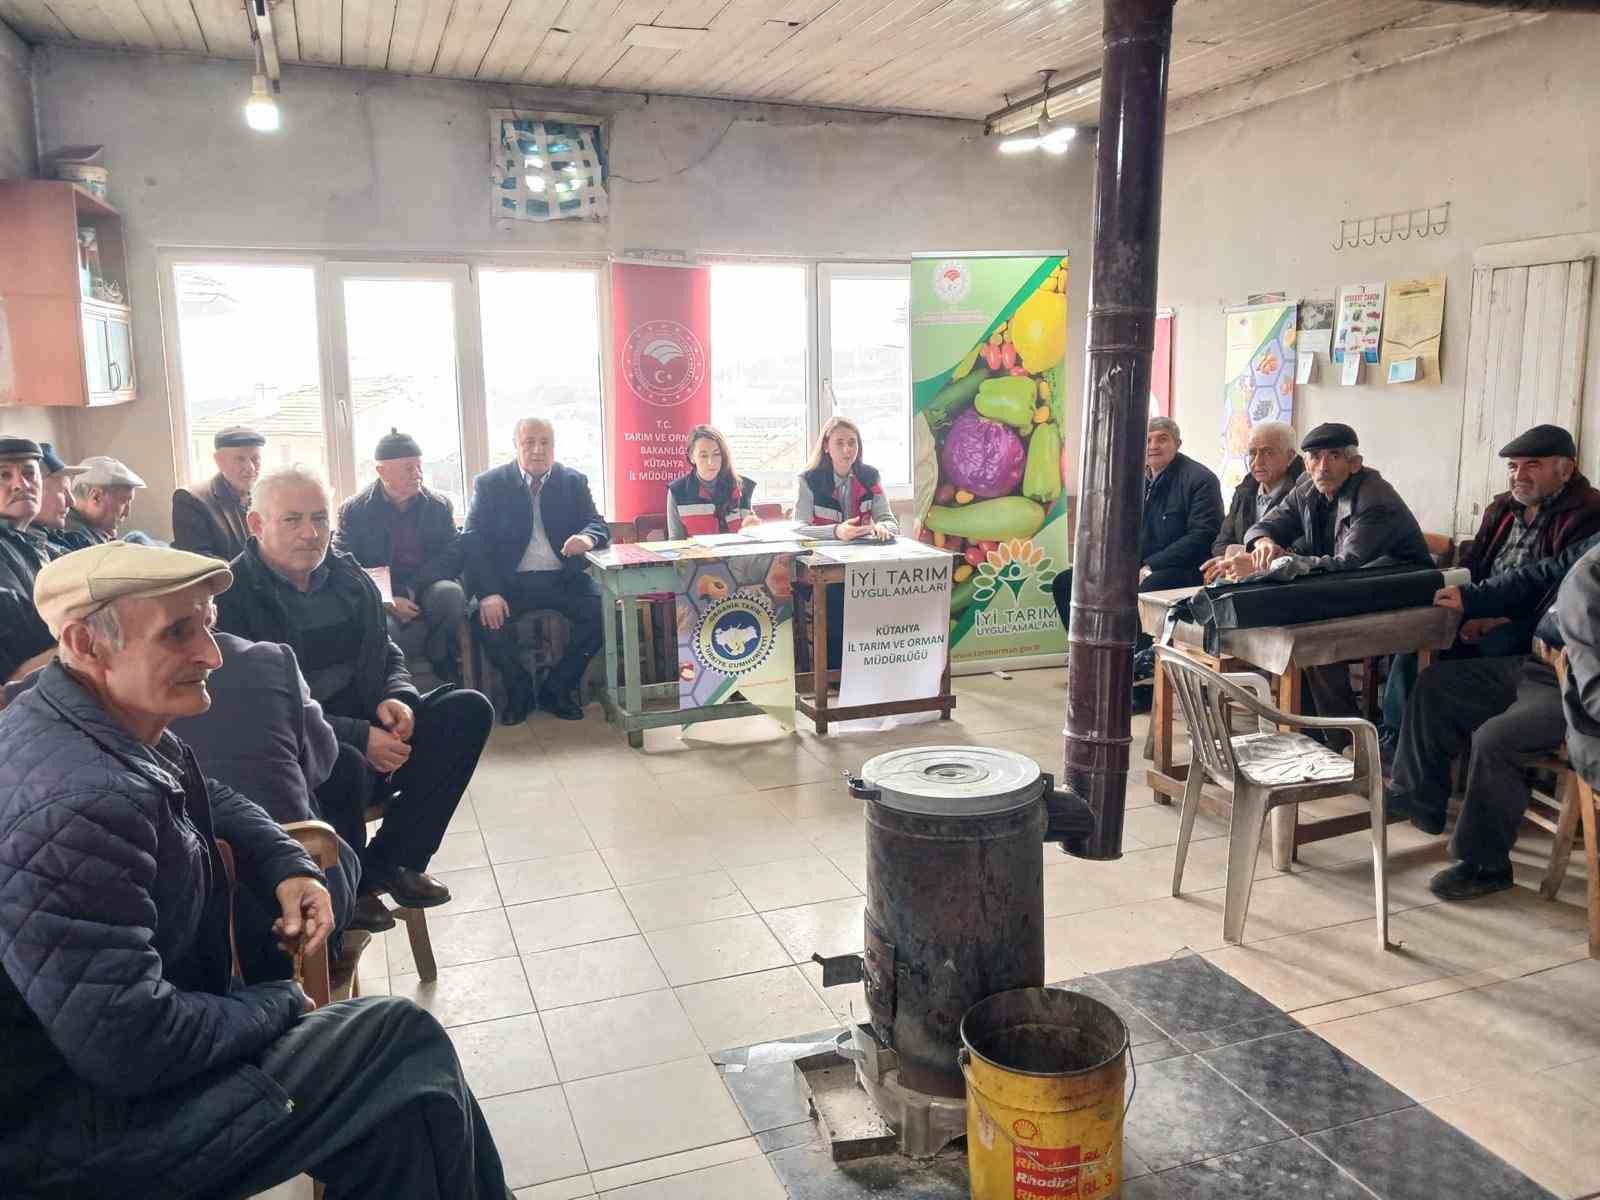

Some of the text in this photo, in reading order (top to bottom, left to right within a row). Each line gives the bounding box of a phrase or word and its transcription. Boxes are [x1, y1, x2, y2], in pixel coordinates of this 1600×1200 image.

[623, 433, 689, 443] TARIM VE ORM
[644, 457, 684, 468] KÜTAHYA
[851, 565, 948, 586] İYİ TARIM
[851, 581, 947, 598] UYGULAMALARI
[1005, 607, 1057, 622] TARIM
[875, 623, 920, 636] KÜTAHYA
[976, 620, 1058, 636] UYGULAMALARI
[848, 640, 857, 652] İL
[893, 639, 905, 649] VE
[907, 634, 945, 648] ORMAN
[863, 649, 928, 666] MÜDÜRLÜĞÜ
